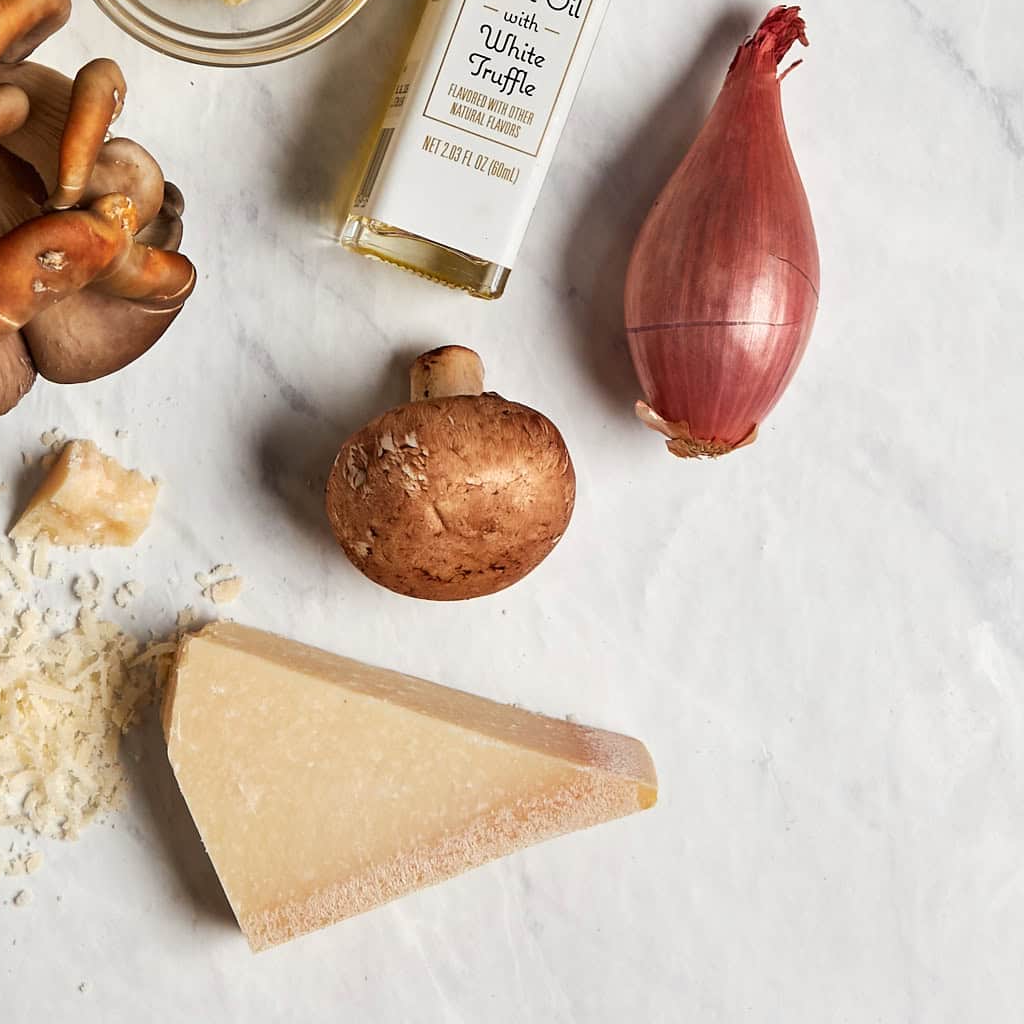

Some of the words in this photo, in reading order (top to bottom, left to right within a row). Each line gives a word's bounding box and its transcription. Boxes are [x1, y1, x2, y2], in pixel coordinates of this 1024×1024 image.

[504, 11, 539, 33] with
[480, 24, 546, 68] White
[469, 52, 536, 97] Truffle
[447, 82, 488, 109] FLAVORED
[487, 97, 509, 118] WITH
[509, 105, 535, 126] OTHER
[449, 101, 487, 126] NATURAL
[486, 115, 521, 138] FLAVORS
[422, 135, 442, 155] NET
[440, 142, 463, 162] 2.03
[461, 149, 473, 167] FL
[474, 154, 489, 173] OZ
[487, 159, 520, 185] (60mL)
